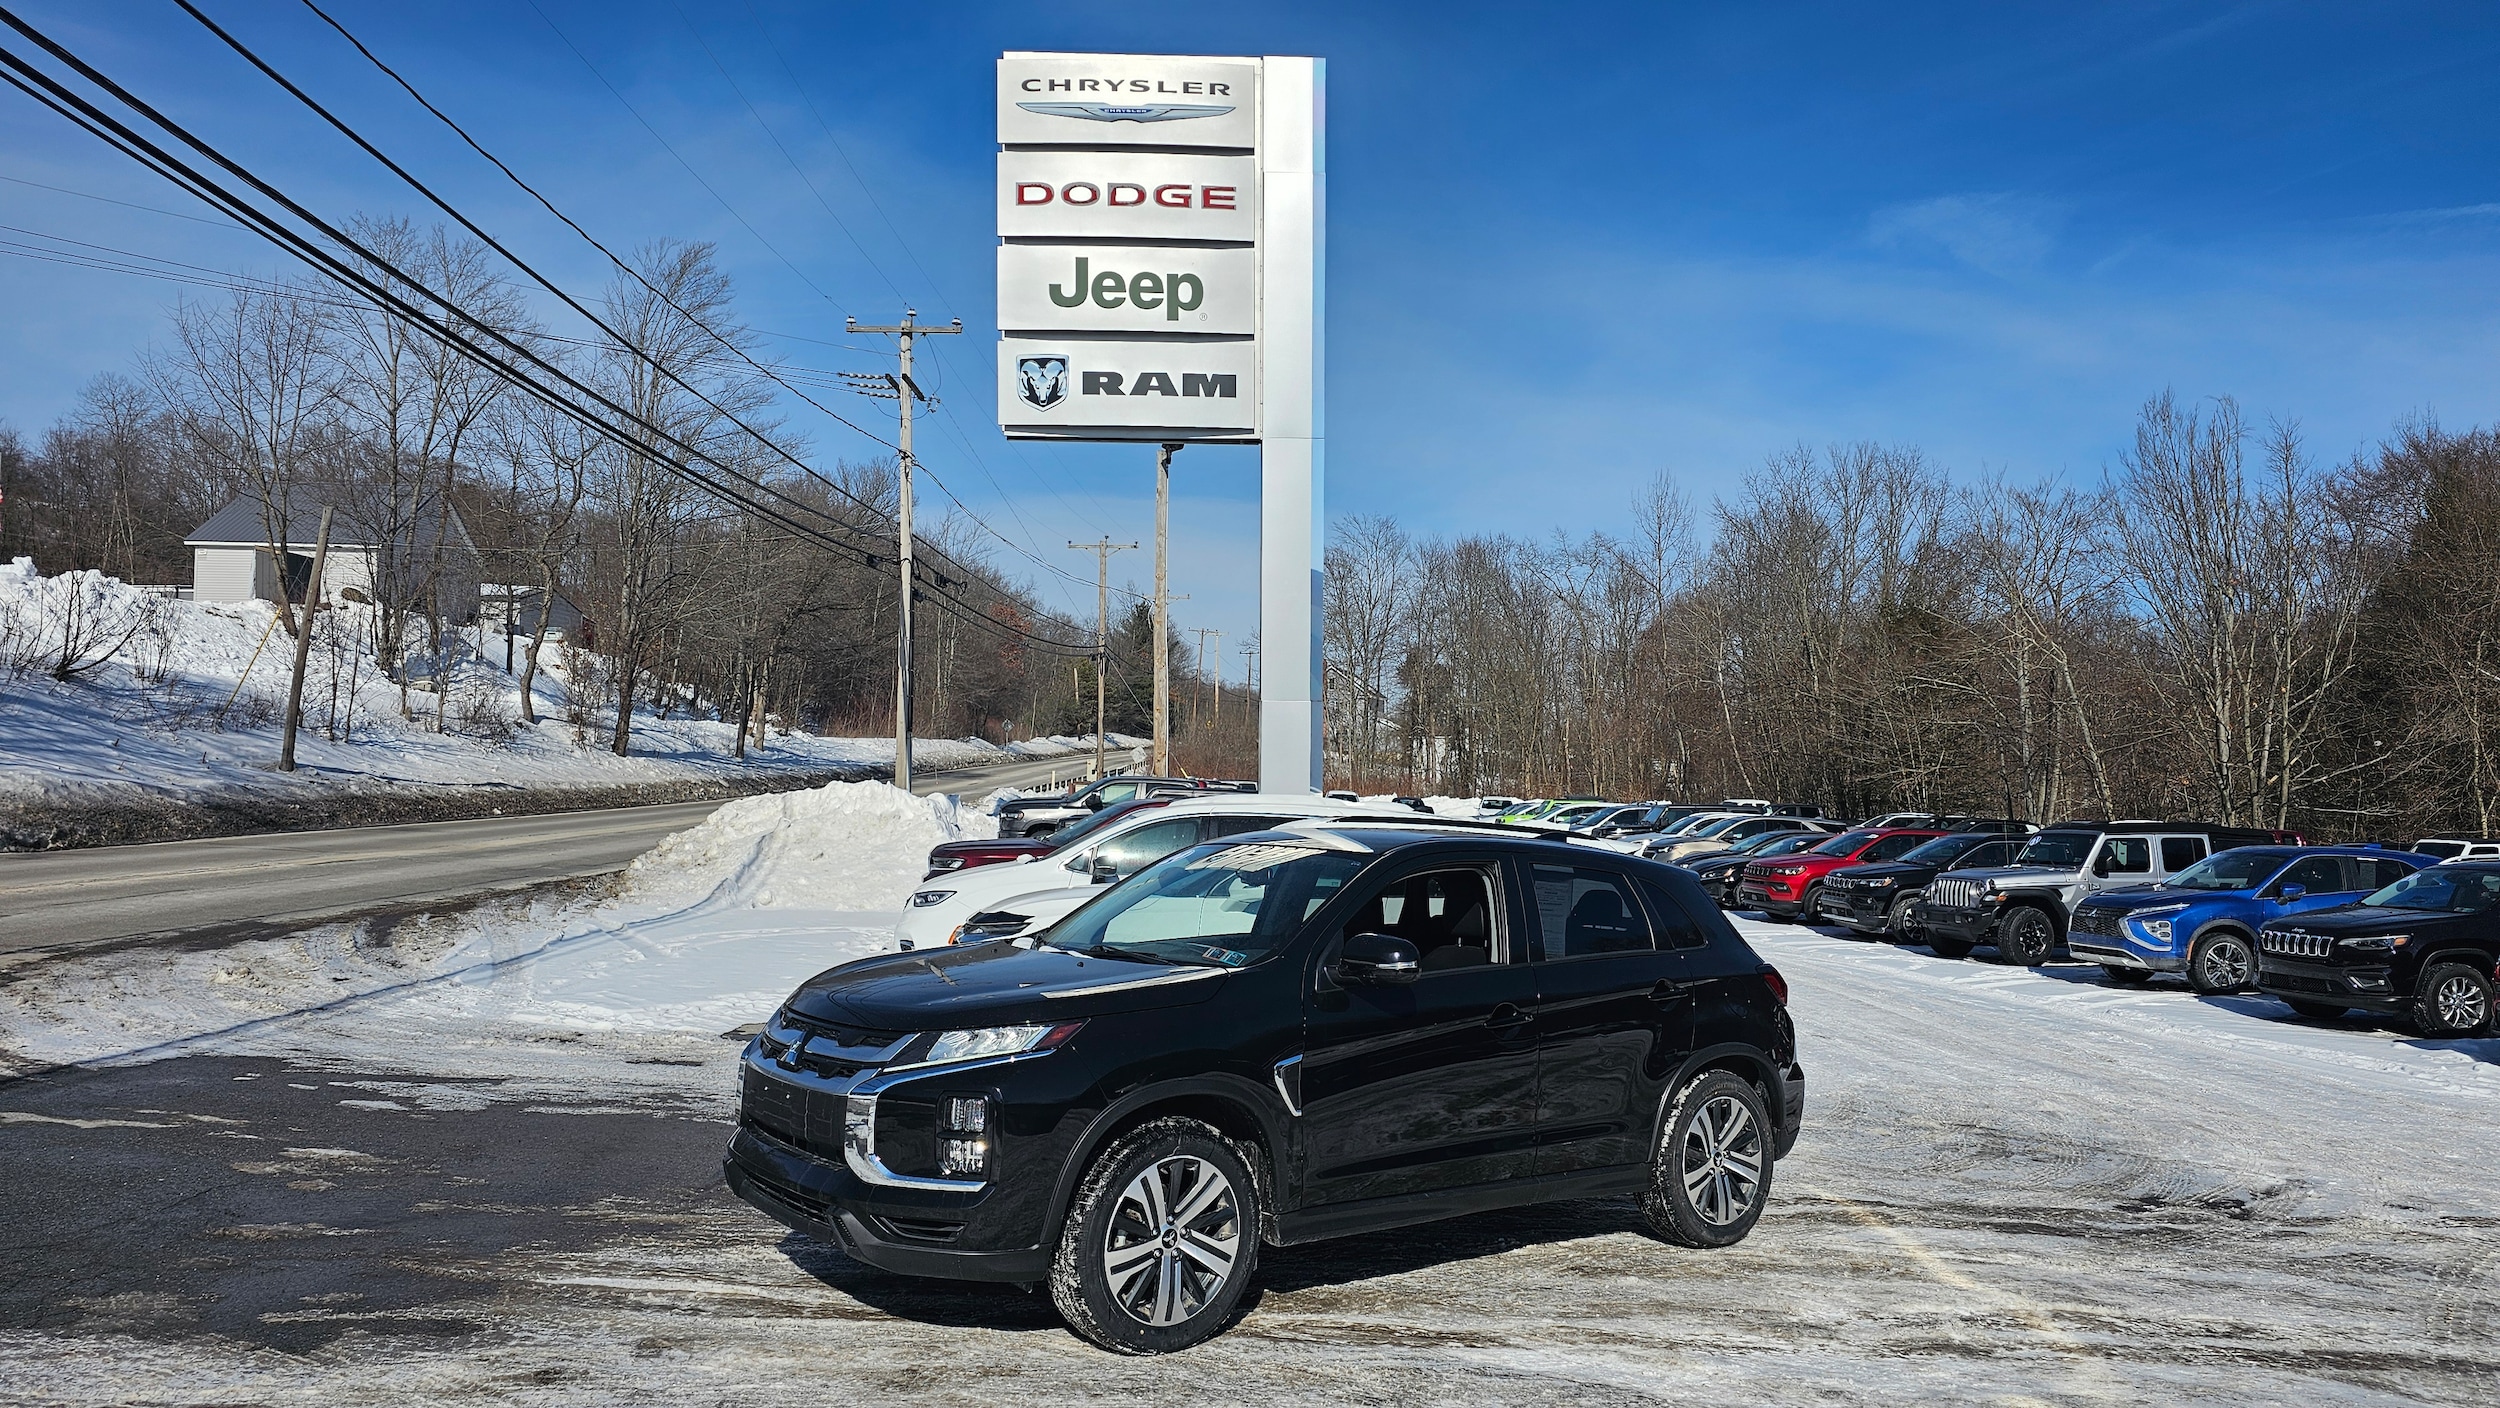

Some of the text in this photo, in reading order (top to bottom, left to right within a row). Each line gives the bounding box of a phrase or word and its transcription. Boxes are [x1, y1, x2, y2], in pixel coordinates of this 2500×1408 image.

[1021, 78, 1231, 96] CHRYSLER
[1015, 181, 1237, 210] DODGE
[1048, 257, 1204, 321] Jeep
[1082, 371, 1237, 398] RAM
